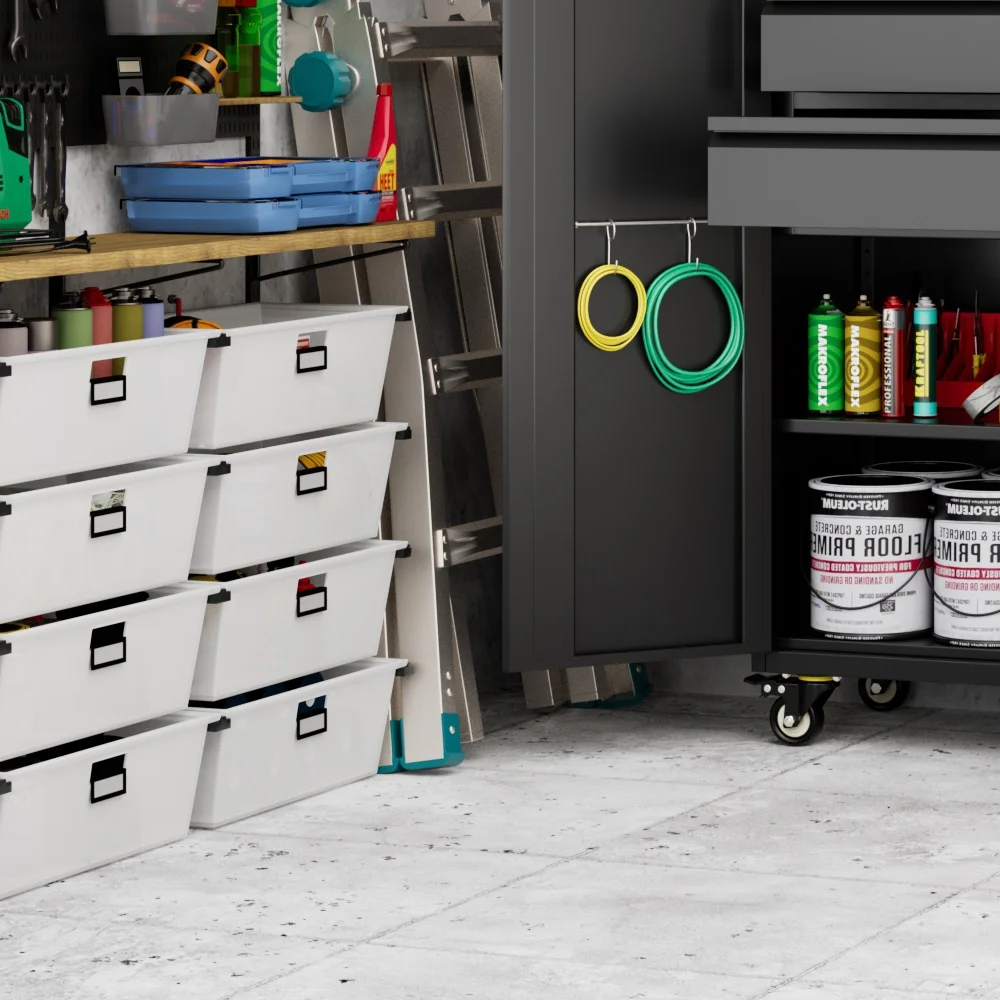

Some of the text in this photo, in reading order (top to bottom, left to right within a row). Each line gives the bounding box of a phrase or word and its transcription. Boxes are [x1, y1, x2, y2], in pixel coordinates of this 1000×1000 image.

[380, 173, 394, 190] HEET
[818, 324, 828, 406] MAKROFLEX
[850, 324, 860, 408] MAKROFLEX
[884, 334, 892, 414] PROFESSIONAL
